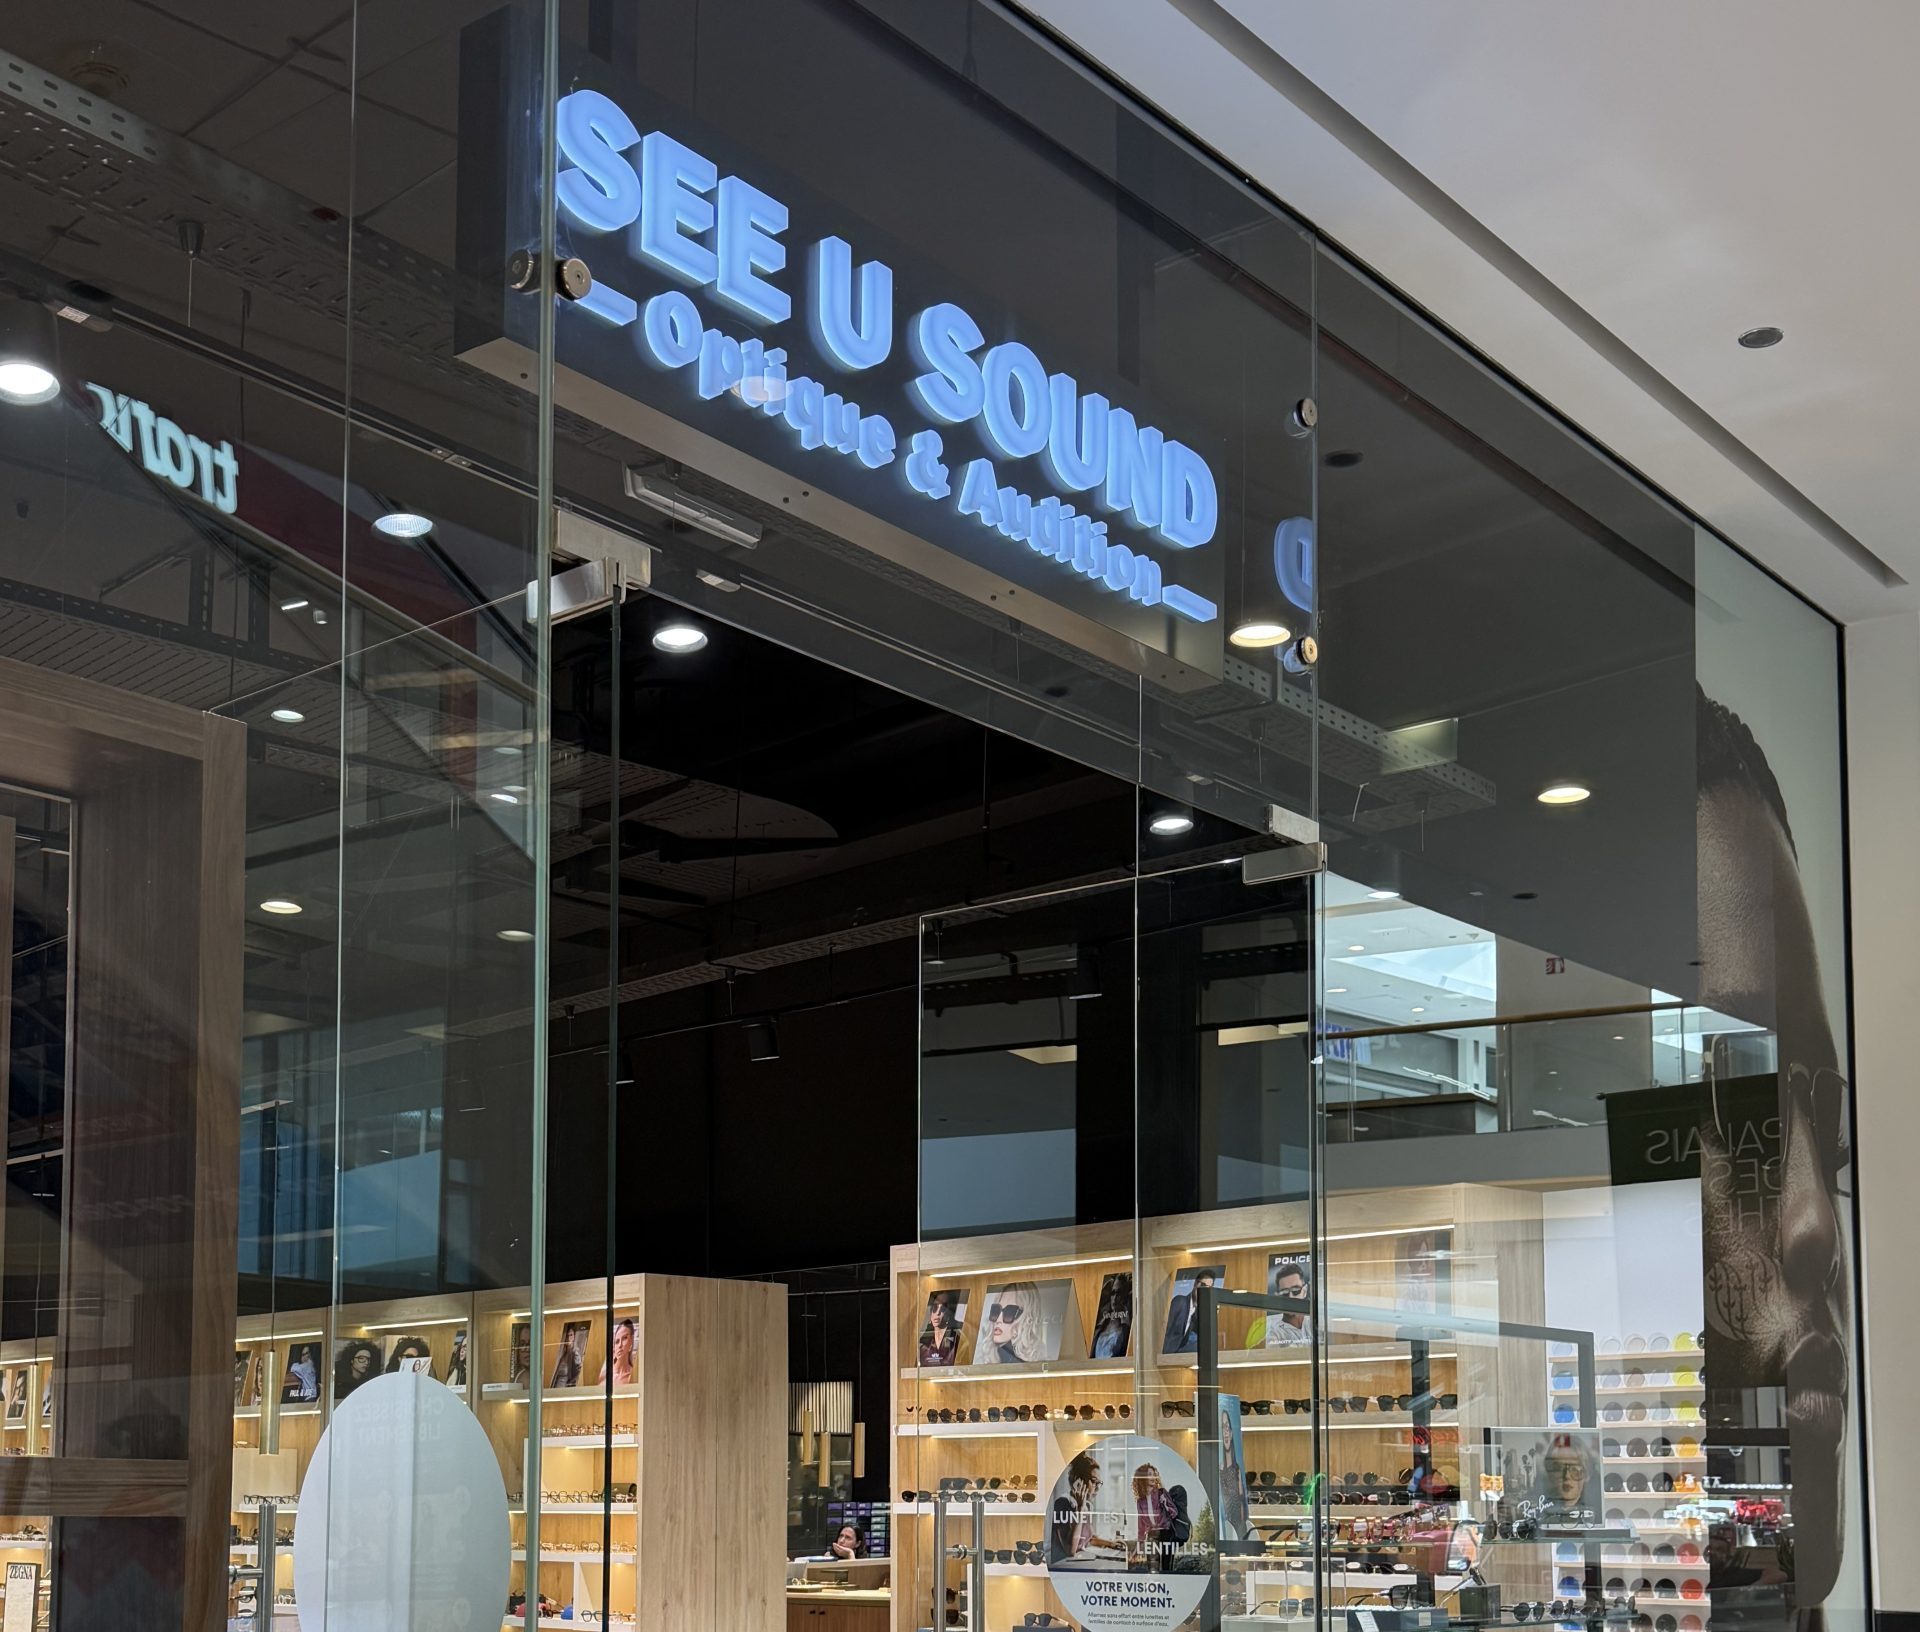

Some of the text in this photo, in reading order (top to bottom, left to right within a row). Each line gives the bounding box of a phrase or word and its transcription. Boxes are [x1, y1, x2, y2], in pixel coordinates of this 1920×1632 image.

[557, 89, 1217, 549] SEE U SOUND
[645, 290, 896, 470] Optique
[905, 429, 950, 499] &
[958, 457, 1162, 606] Audition
[1274, 1254, 1310, 1265] POLICE
[1053, 1510, 1119, 1524] LUNETTES
[1136, 1541, 1208, 1556] LENTILLES
[9, 1565, 33, 1580] ZEGNA
[1085, 1581, 1170, 1596] VOTRE VISION,
[1080, 1595, 1175, 1608] VOTRE MOMENT.
